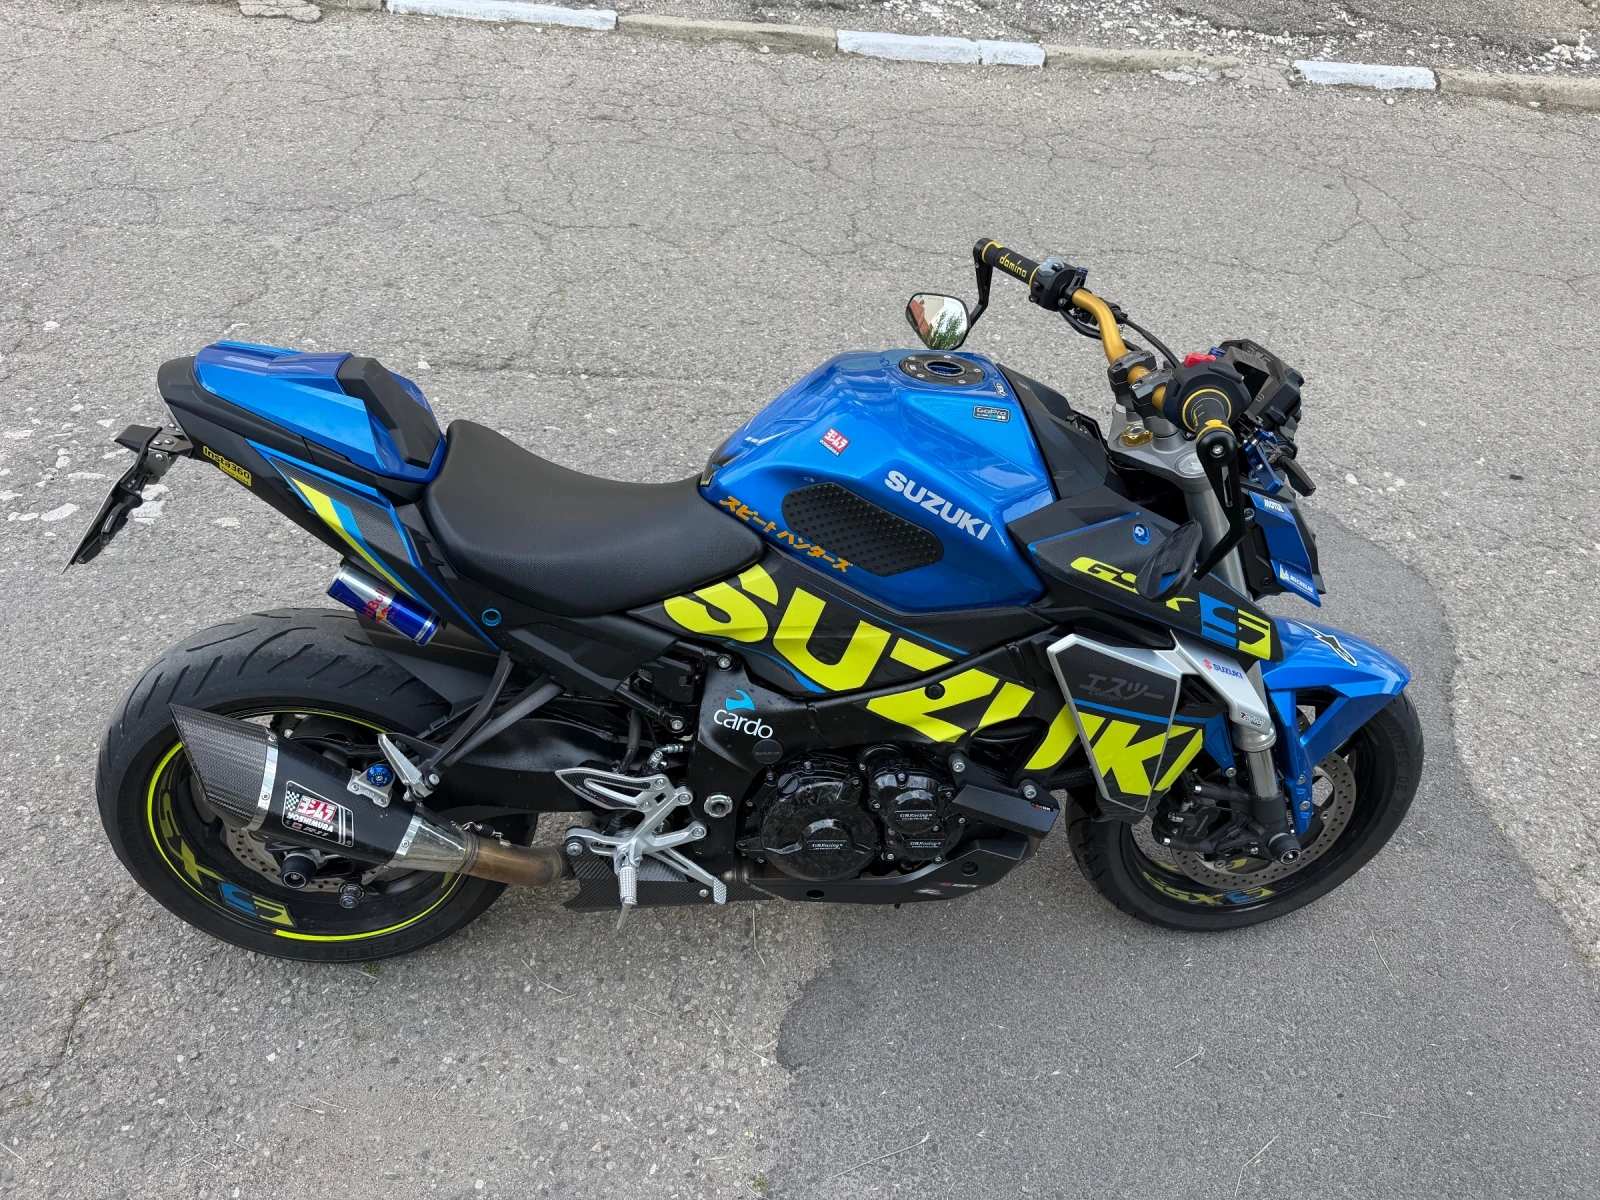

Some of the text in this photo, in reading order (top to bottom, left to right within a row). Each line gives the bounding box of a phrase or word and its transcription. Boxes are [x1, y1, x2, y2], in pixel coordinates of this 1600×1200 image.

[999, 253, 1028, 278] domino
[976, 407, 1007, 416] GoPro
[204, 447, 250, 479] Insta360
[884, 470, 991, 541] SUZUKI
[1289, 574, 1314, 592] MICHELIN
[664, 563, 1203, 796] SUZUKI
[1212, 663, 1244, 680] SUZUKI
[1079, 673, 1165, 701] エスツー
[713, 708, 774, 739] cardo
[286, 811, 334, 833] YOSHIMURA
[297, 796, 337, 822] ヨシムラ
